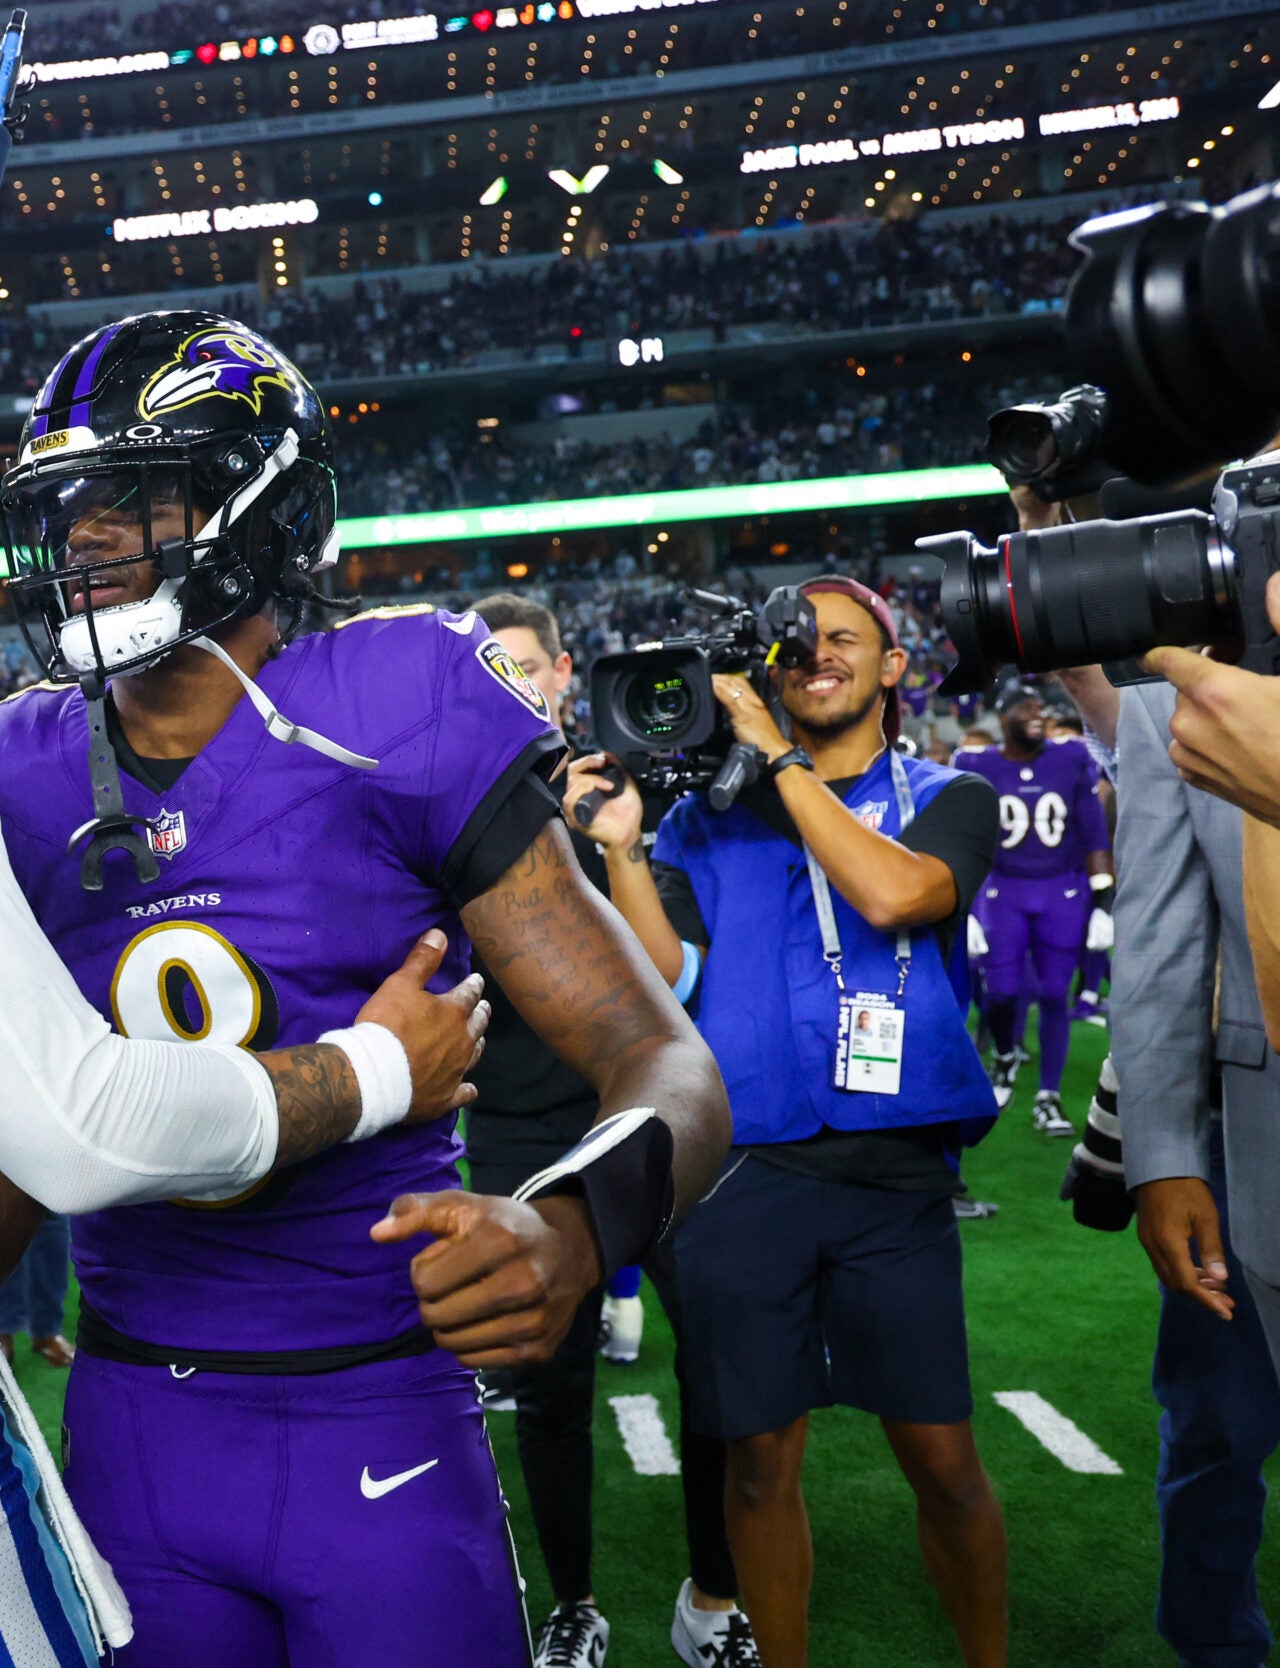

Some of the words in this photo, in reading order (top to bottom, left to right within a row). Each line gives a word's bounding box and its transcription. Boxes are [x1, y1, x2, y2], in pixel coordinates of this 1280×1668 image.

[30, 431, 69, 455] RAVENS
[999, 792, 1067, 849] 90
[154, 830, 180, 850] NFL
[126, 893, 221, 918] RAVENS
